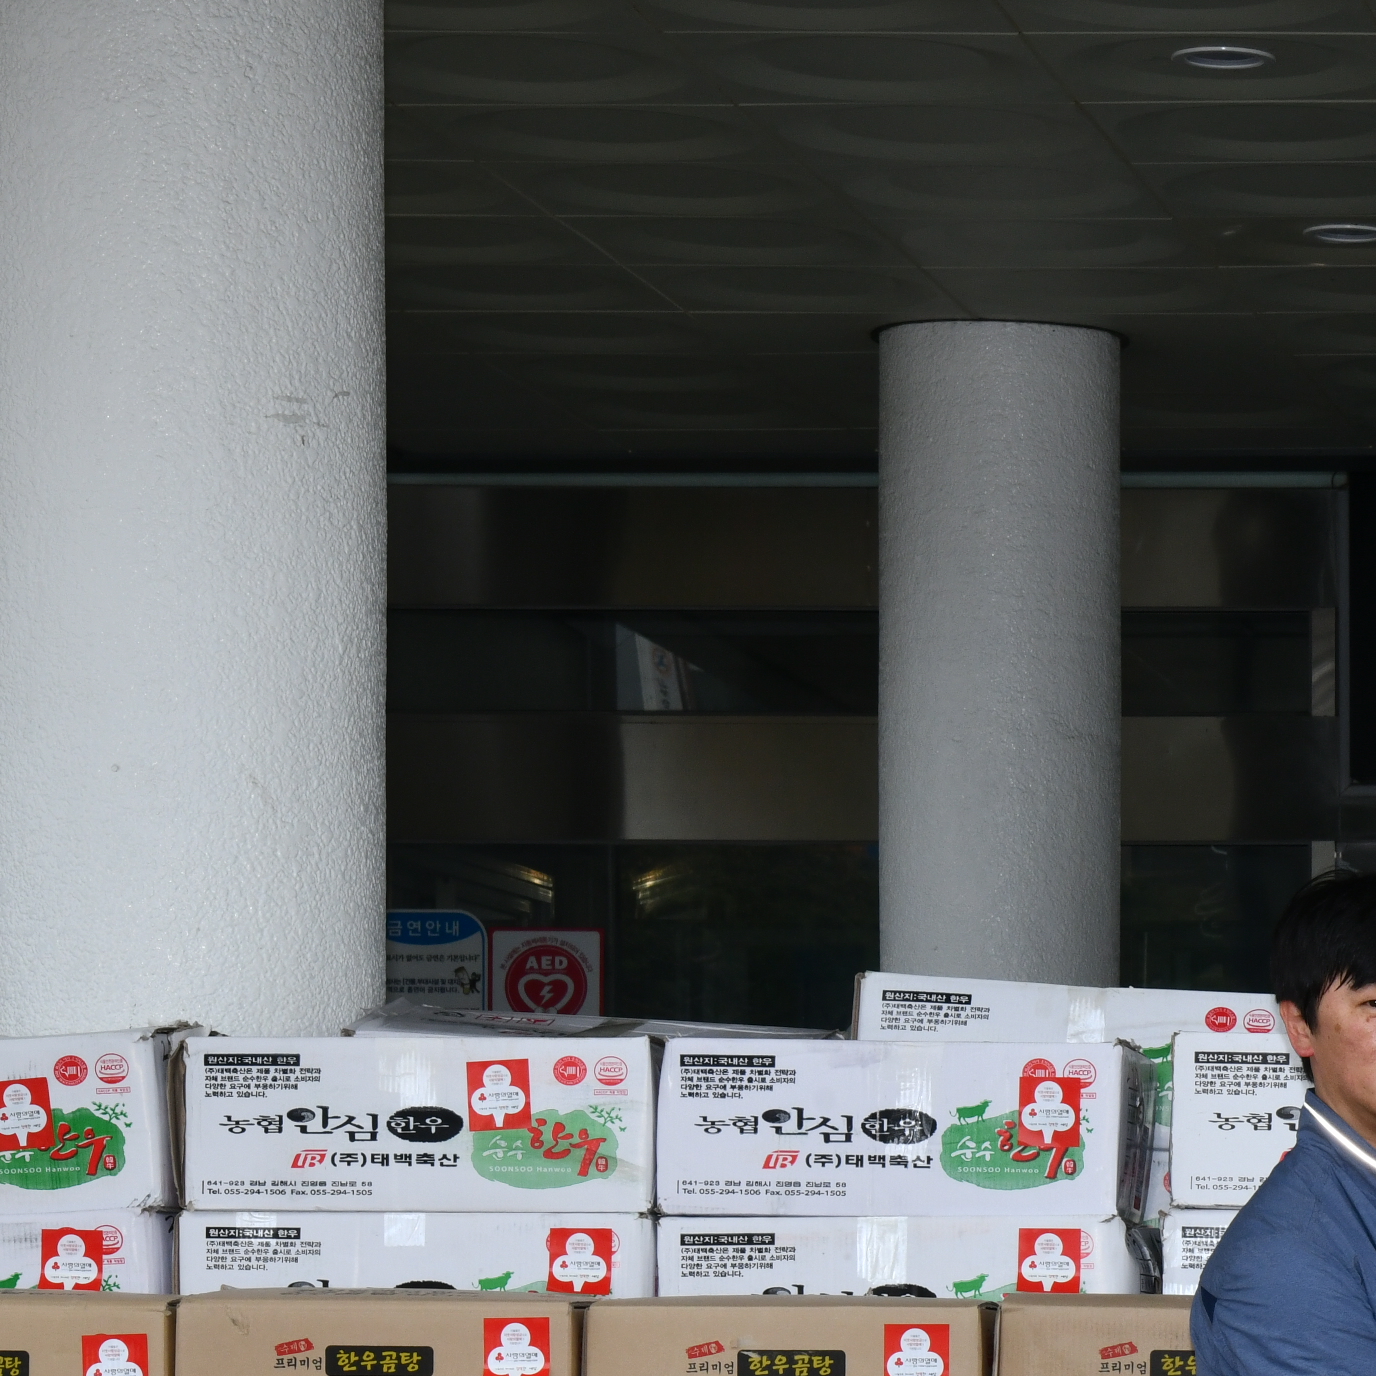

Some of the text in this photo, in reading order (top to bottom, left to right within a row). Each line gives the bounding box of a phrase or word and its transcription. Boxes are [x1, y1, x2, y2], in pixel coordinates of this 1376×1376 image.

[525, 956, 568, 970] AED
[207, 1055, 298, 1065] 원산지:국내산 한우
[219, 1114, 284, 1134] 농협
[390, 1115, 450, 1135] 한우
[694, 1115, 759, 1135] 농협
[330, 1151, 460, 1168] (주)태백축산
[805, 1153, 934, 1169] (주)태백축산
[489, 1165, 572, 1173] SOONSOO Hanwoo
[207, 1188, 222, 1196] Tel.
[224, 1188, 287, 1196] 055-294-1506
[309, 1188, 373, 1196] 055-294-1505
[273, 1350, 422, 1373] 프리미엄 한우곰탕
